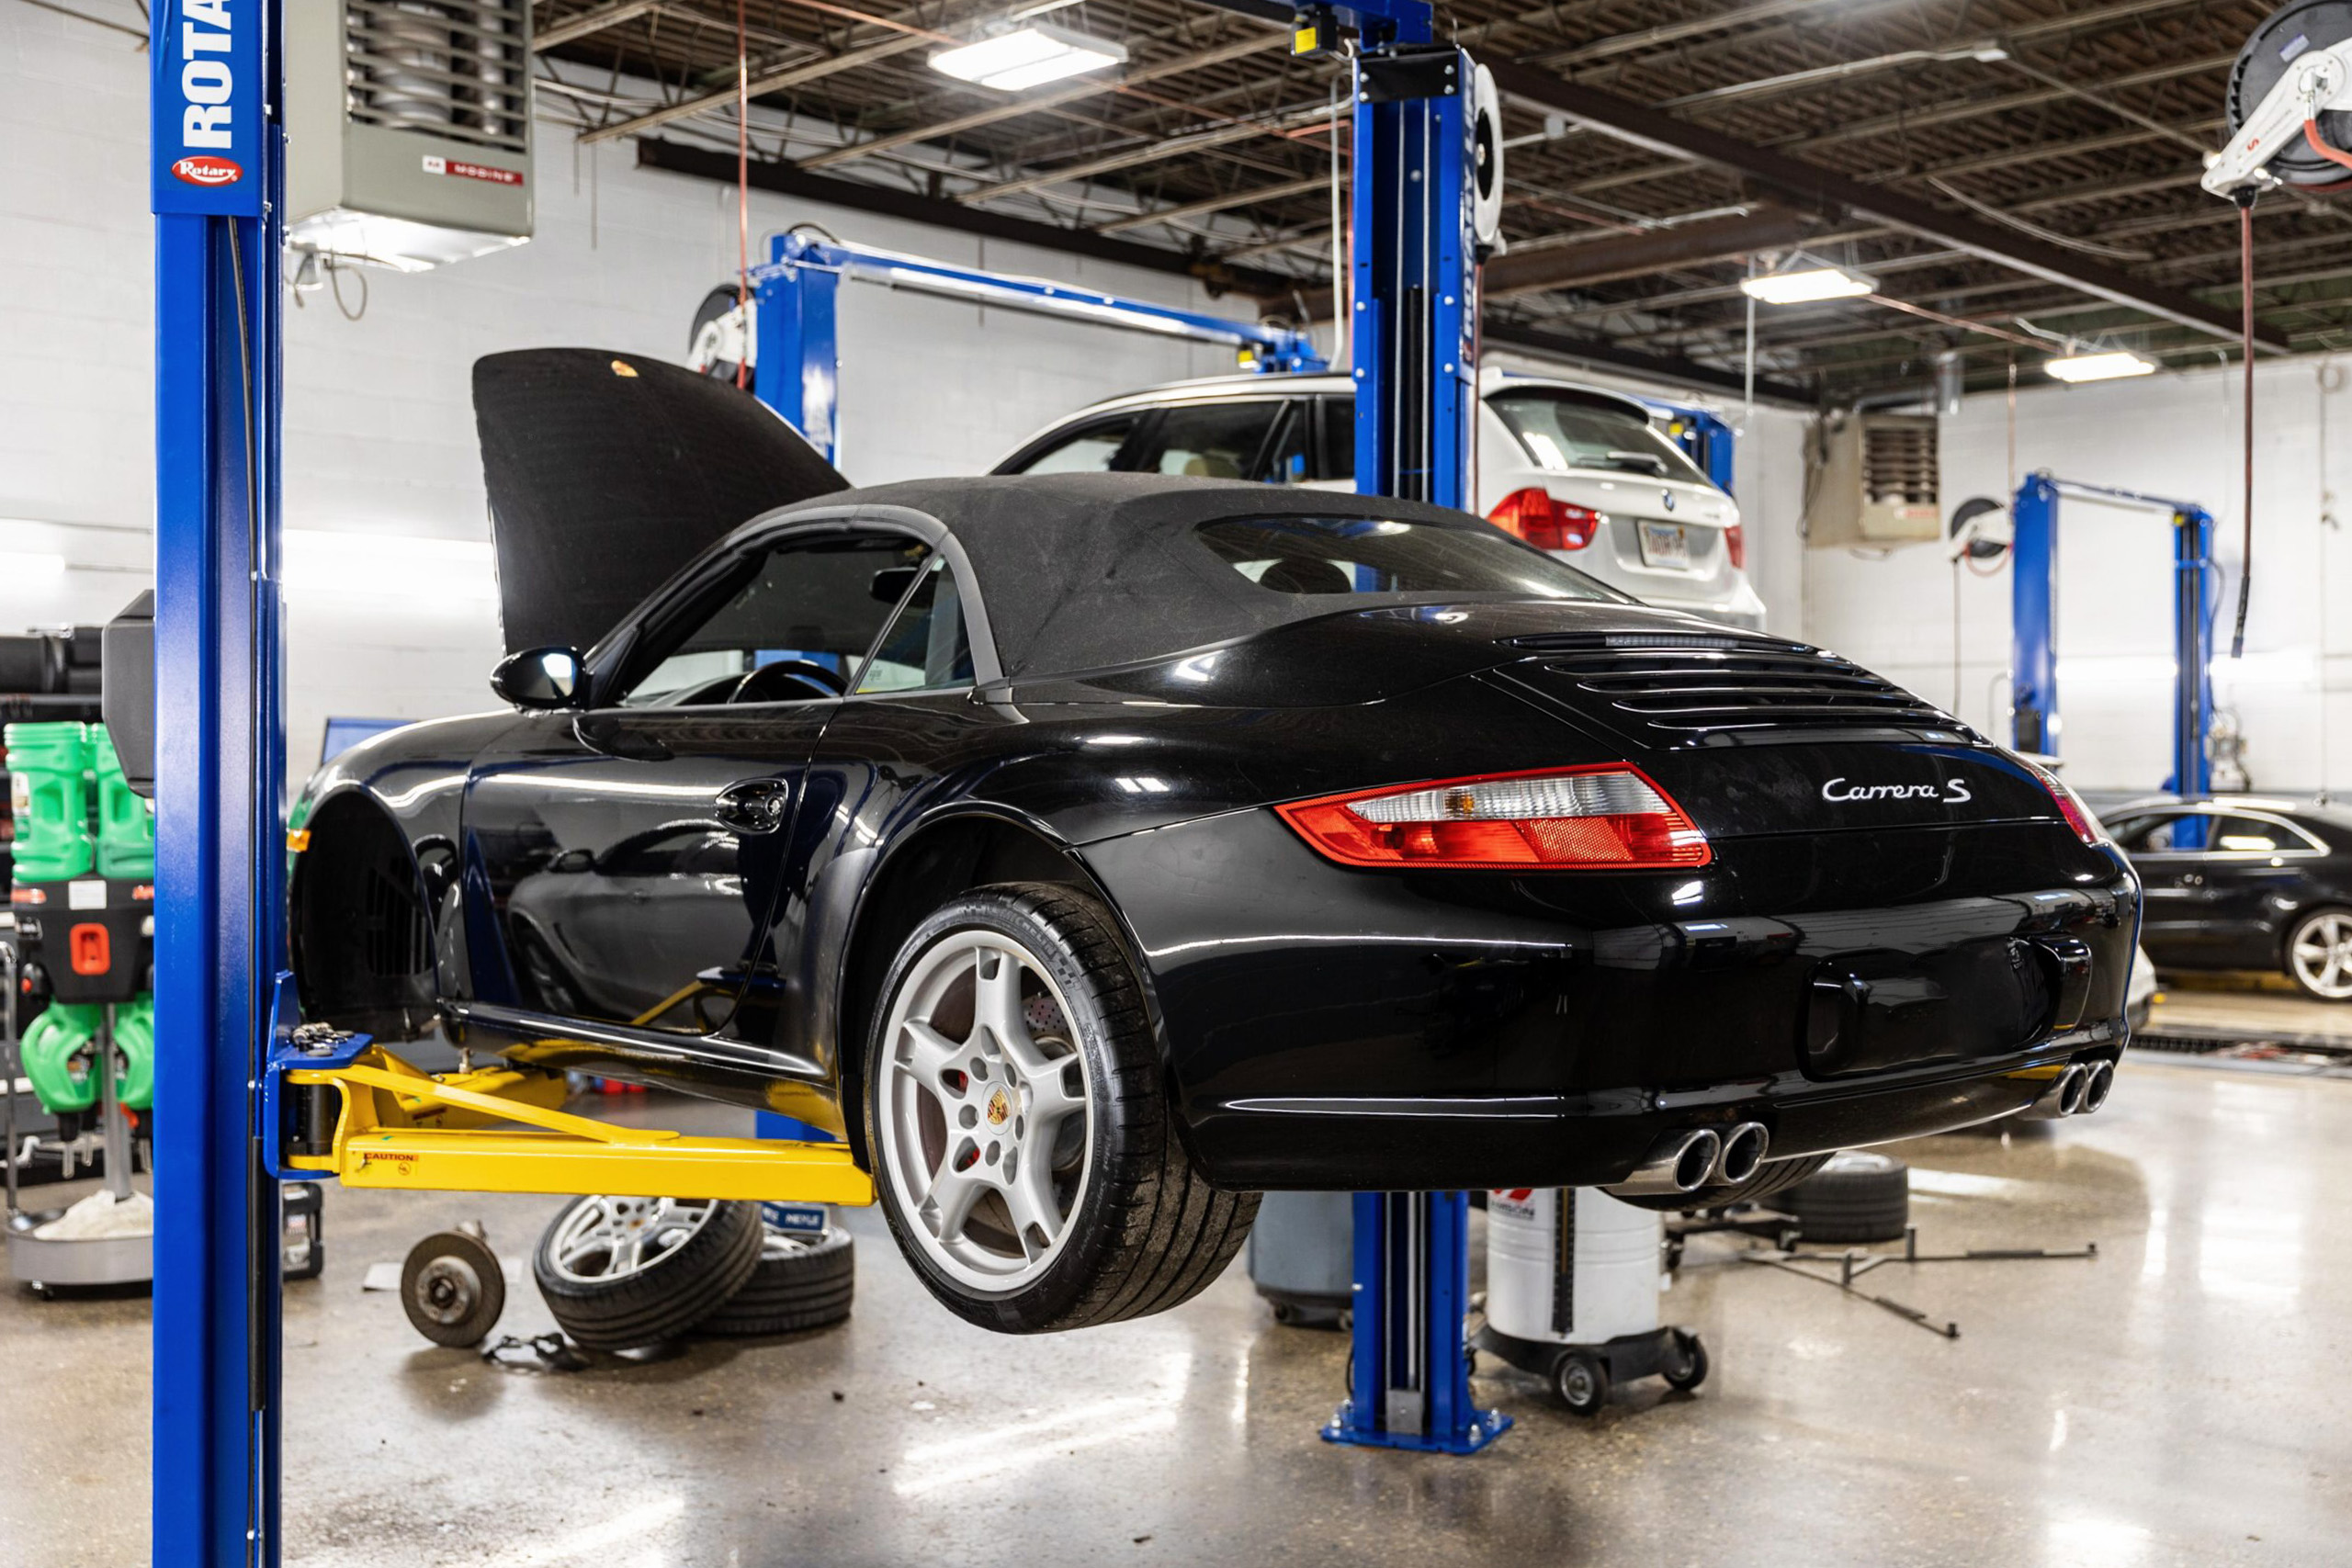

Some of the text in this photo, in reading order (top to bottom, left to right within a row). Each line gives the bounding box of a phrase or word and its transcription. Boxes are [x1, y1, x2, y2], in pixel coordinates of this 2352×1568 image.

[178, 160, 236, 178] Rotary
[1822, 777, 1972, 803] Carrera S
[364, 1152, 413, 1162] CAUTION
